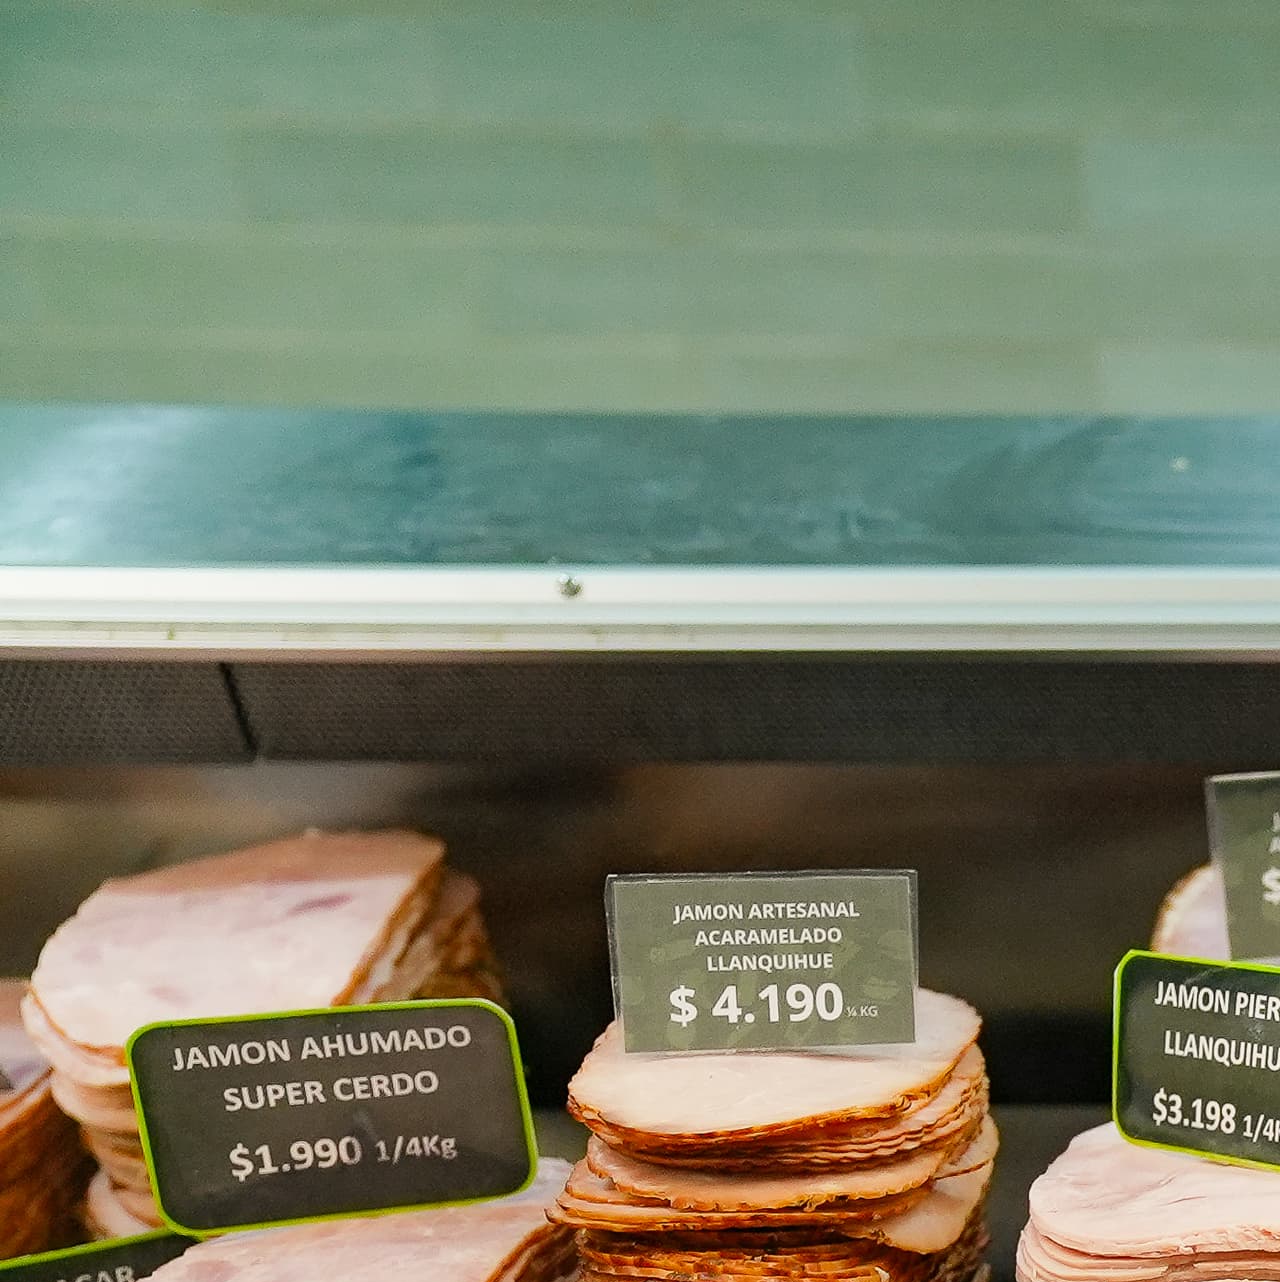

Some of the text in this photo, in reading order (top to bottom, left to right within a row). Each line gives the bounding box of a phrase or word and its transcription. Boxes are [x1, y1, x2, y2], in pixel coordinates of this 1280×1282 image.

[673, 901, 861, 925] JAMON ARTESANAL
[695, 927, 843, 946] ACARAMELADO
[707, 952, 834, 974] LLANQUIHUE
[669, 984, 698, 1028] $
[711, 982, 844, 1024] 4.190
[860, 1005, 879, 1017] KG
[1154, 981, 1231, 1014] JAMON
[172, 1025, 473, 1072] JAMON AHUMADO
[223, 1070, 440, 1113] SUPER CERDO
[1152, 1087, 1237, 1135] $3.198
[228, 1134, 459, 1183] $1.990 1/4Kg
